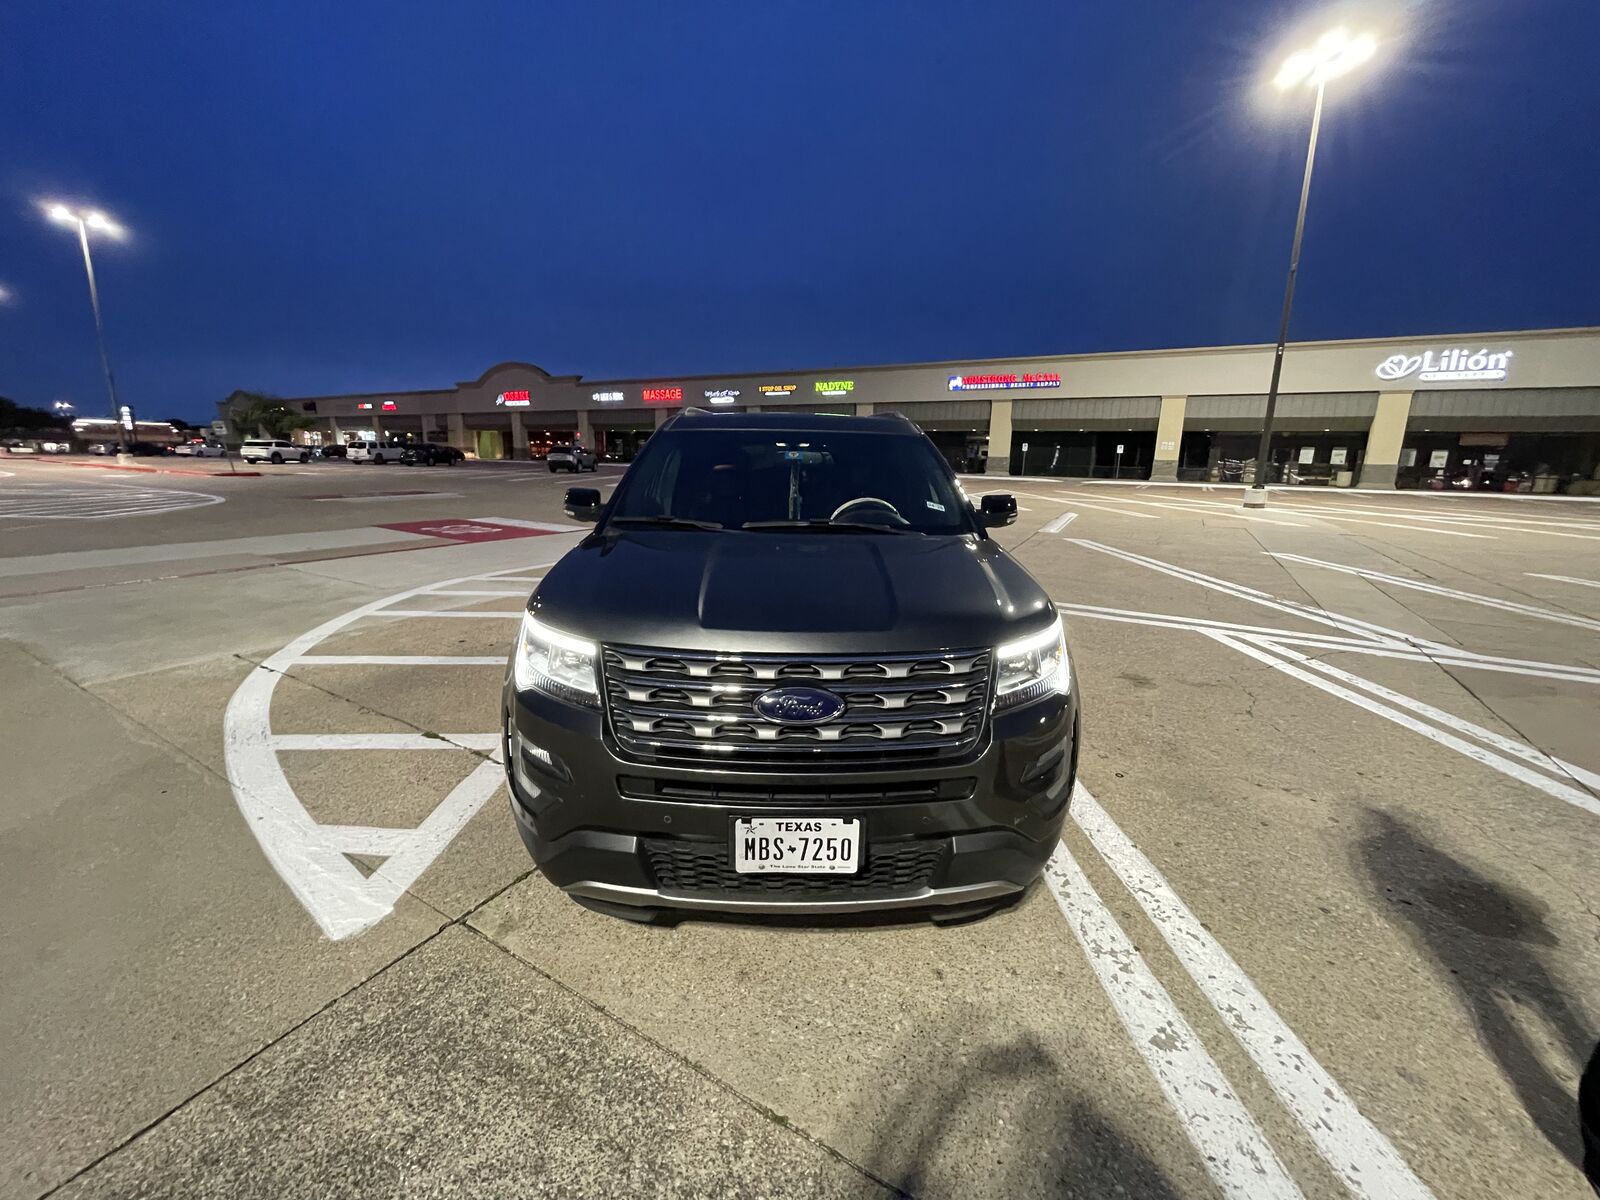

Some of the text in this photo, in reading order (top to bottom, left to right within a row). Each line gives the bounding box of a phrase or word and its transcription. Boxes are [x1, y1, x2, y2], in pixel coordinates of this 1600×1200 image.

[1420, 348, 1507, 372] Lilión
[962, 374, 1017, 384] ARMSTRONG
[815, 381, 854, 391] NADYNE
[503, 390, 530, 401] OSAKI
[643, 388, 682, 400] MASSAGE
[775, 822, 822, 832] TEXAS
